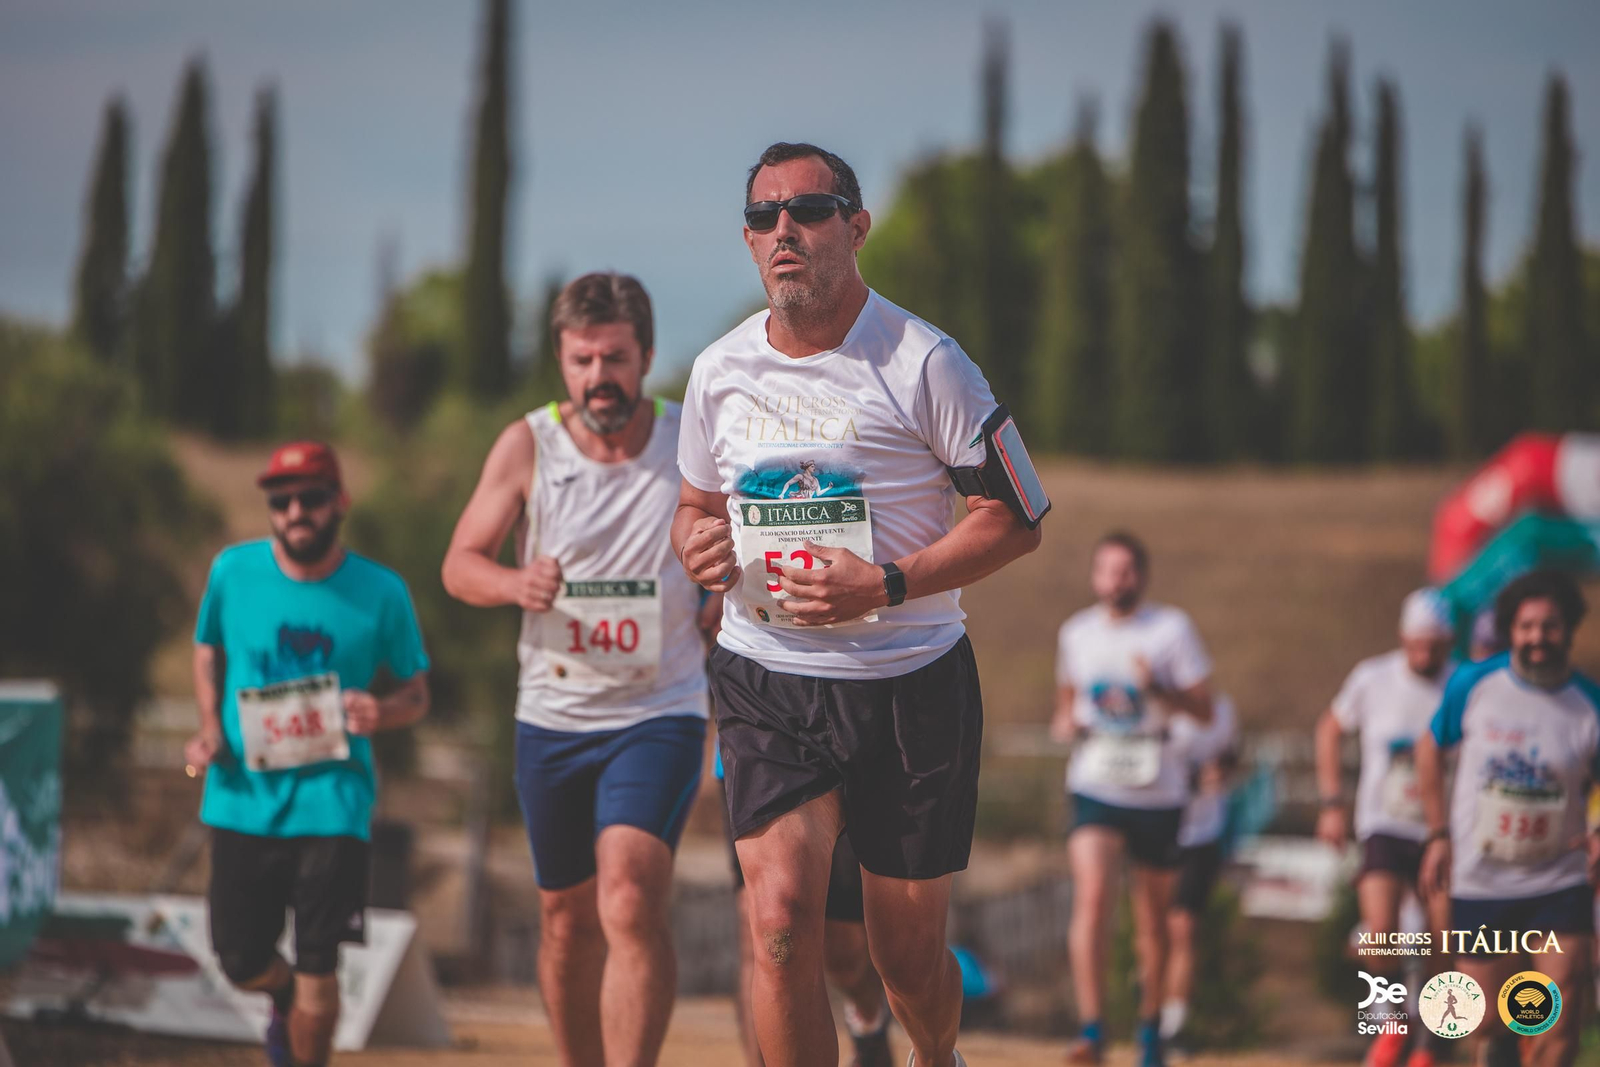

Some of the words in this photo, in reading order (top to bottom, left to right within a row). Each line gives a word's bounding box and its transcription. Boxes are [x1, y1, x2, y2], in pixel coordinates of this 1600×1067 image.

[801, 396, 846, 408] CROSS
[768, 505, 830, 521] ITÁLICA
[566, 618, 640, 654] 140
